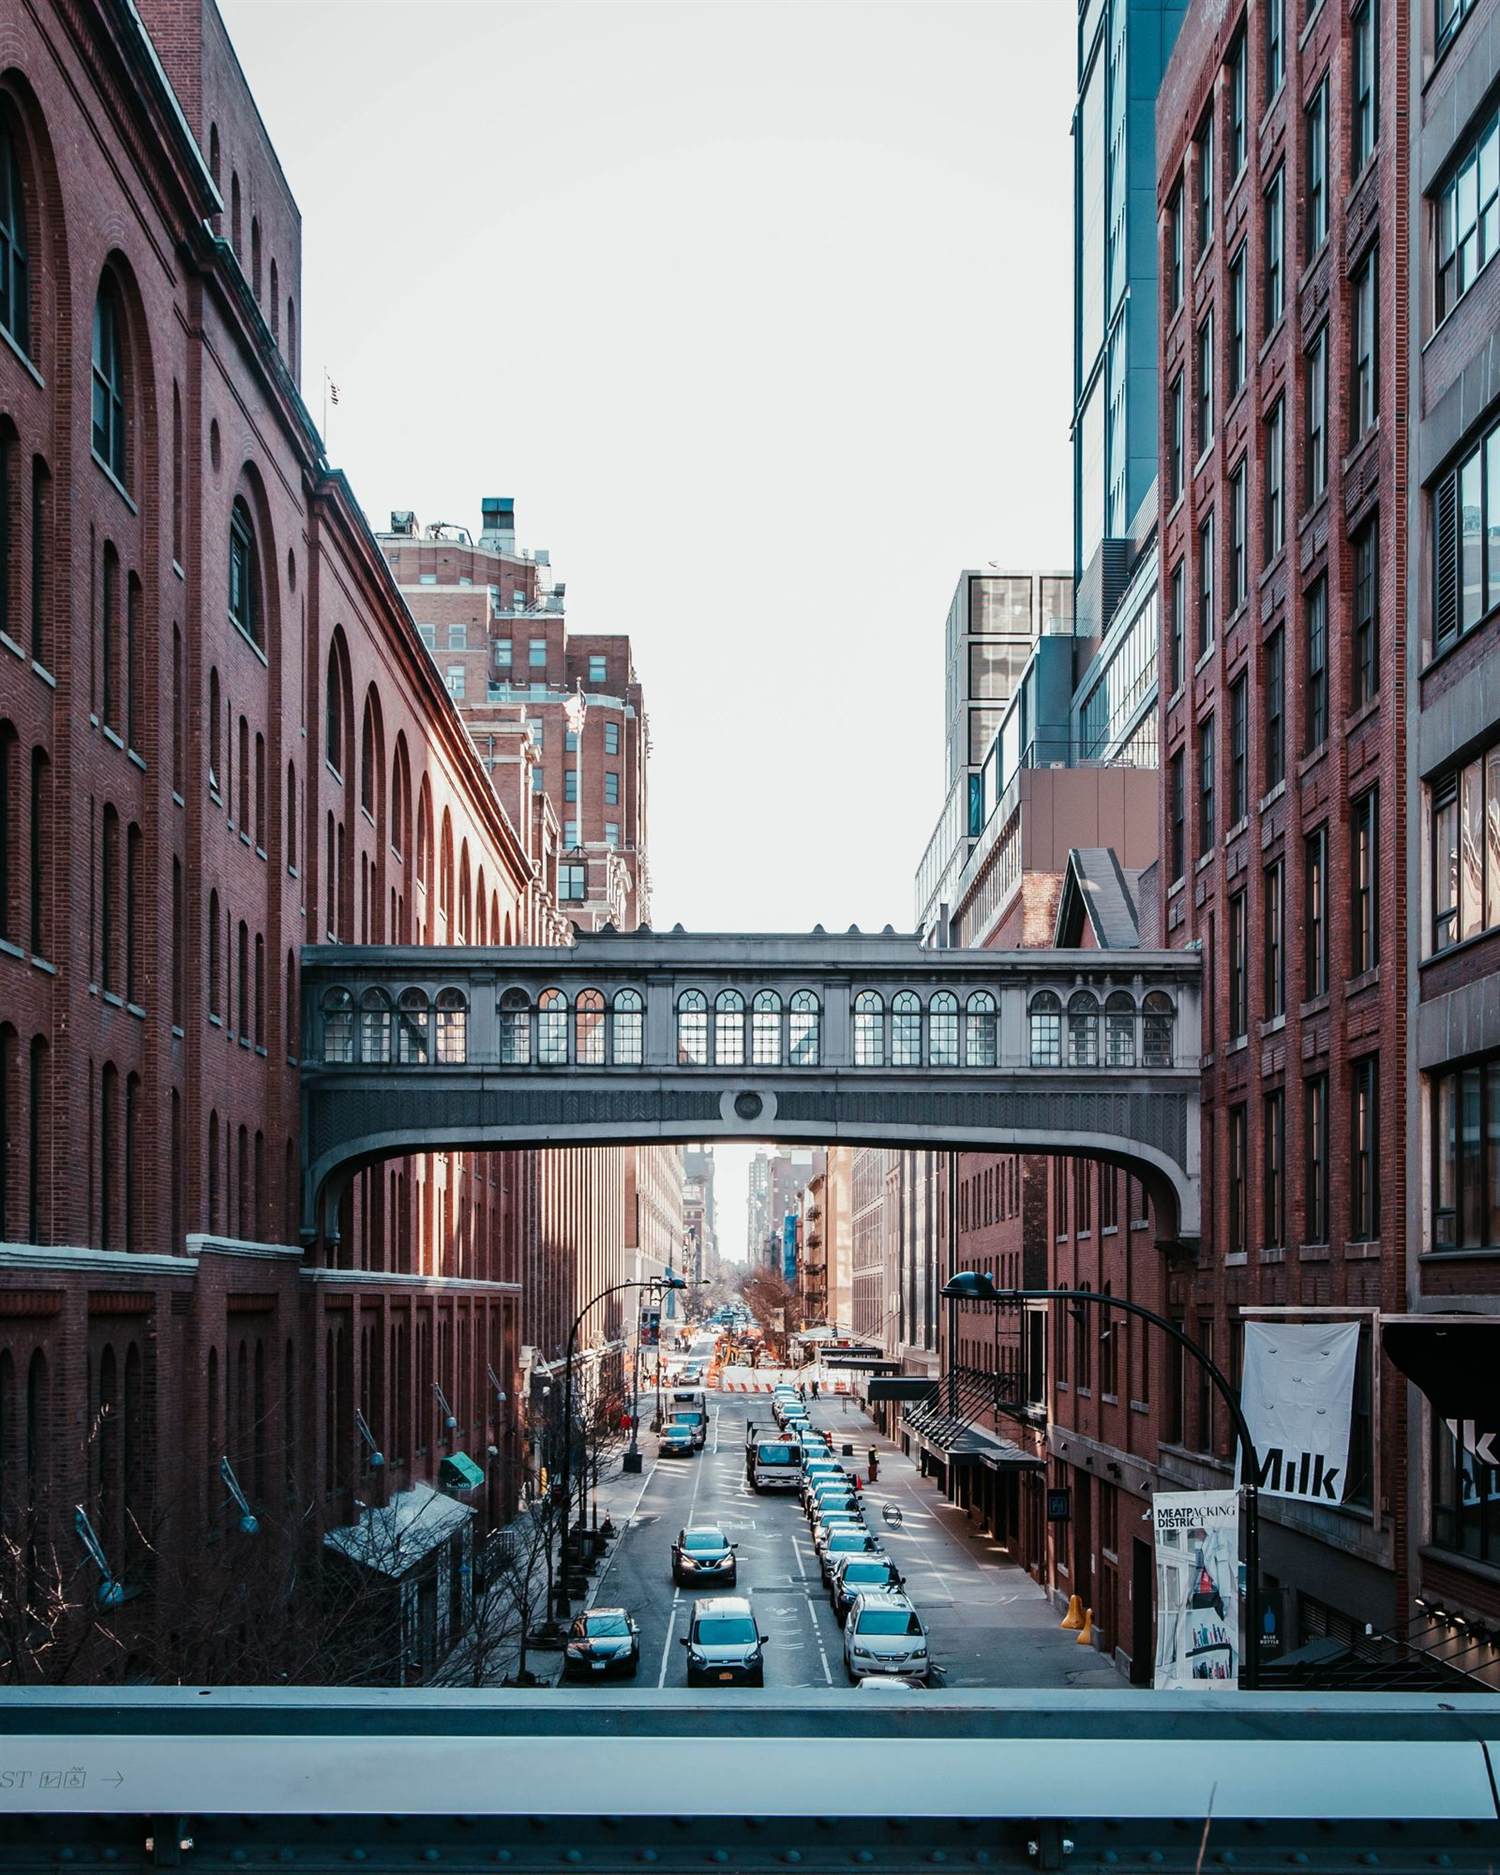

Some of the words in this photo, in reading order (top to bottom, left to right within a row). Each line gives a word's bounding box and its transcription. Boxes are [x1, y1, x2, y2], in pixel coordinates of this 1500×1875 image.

[1241, 1446, 1340, 1500] Milk
[1157, 1505, 1236, 1519] MEATPACKING
[1158, 1517, 1205, 1528] DISTRICT
